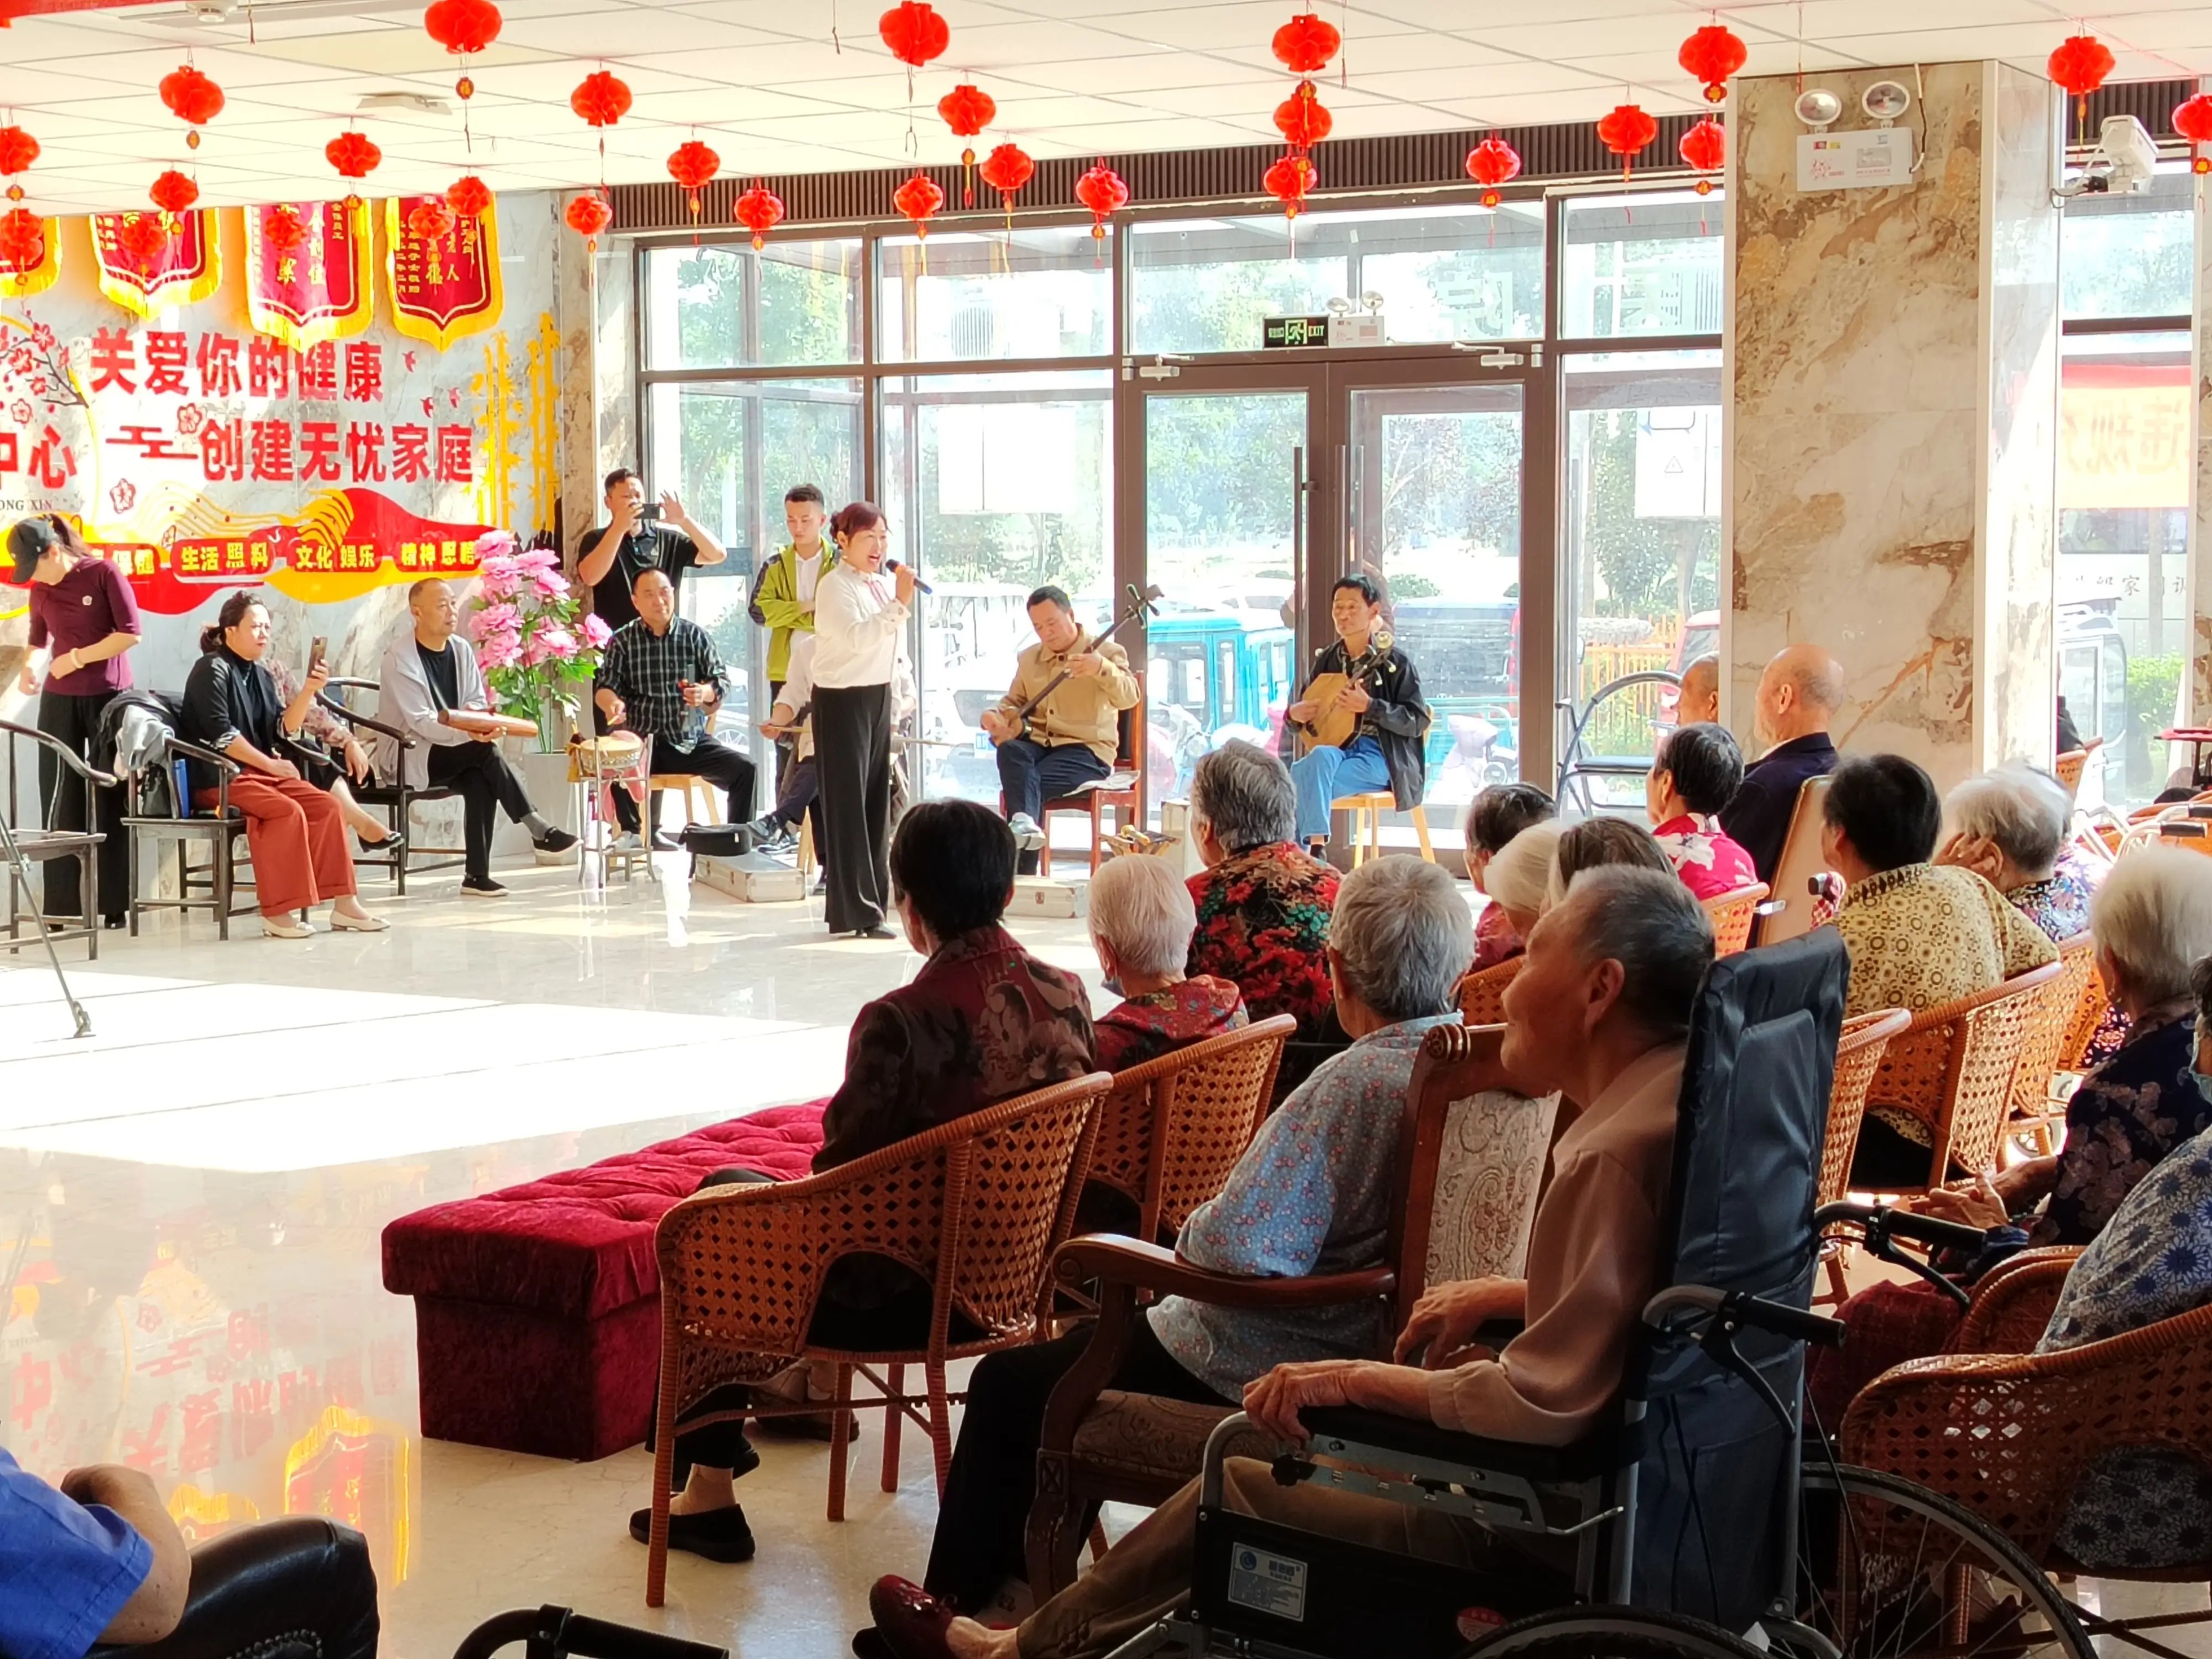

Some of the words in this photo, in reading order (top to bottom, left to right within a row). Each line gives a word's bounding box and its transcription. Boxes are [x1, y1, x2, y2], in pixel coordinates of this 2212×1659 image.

[89, 327, 383, 403] 关爱你的健康
[197, 418, 473, 483] 创建无忧家庭
[31, 499, 52, 510] XIN
[181, 542, 268, 571] 生活照料
[296, 544, 375, 570] 文化娱乐
